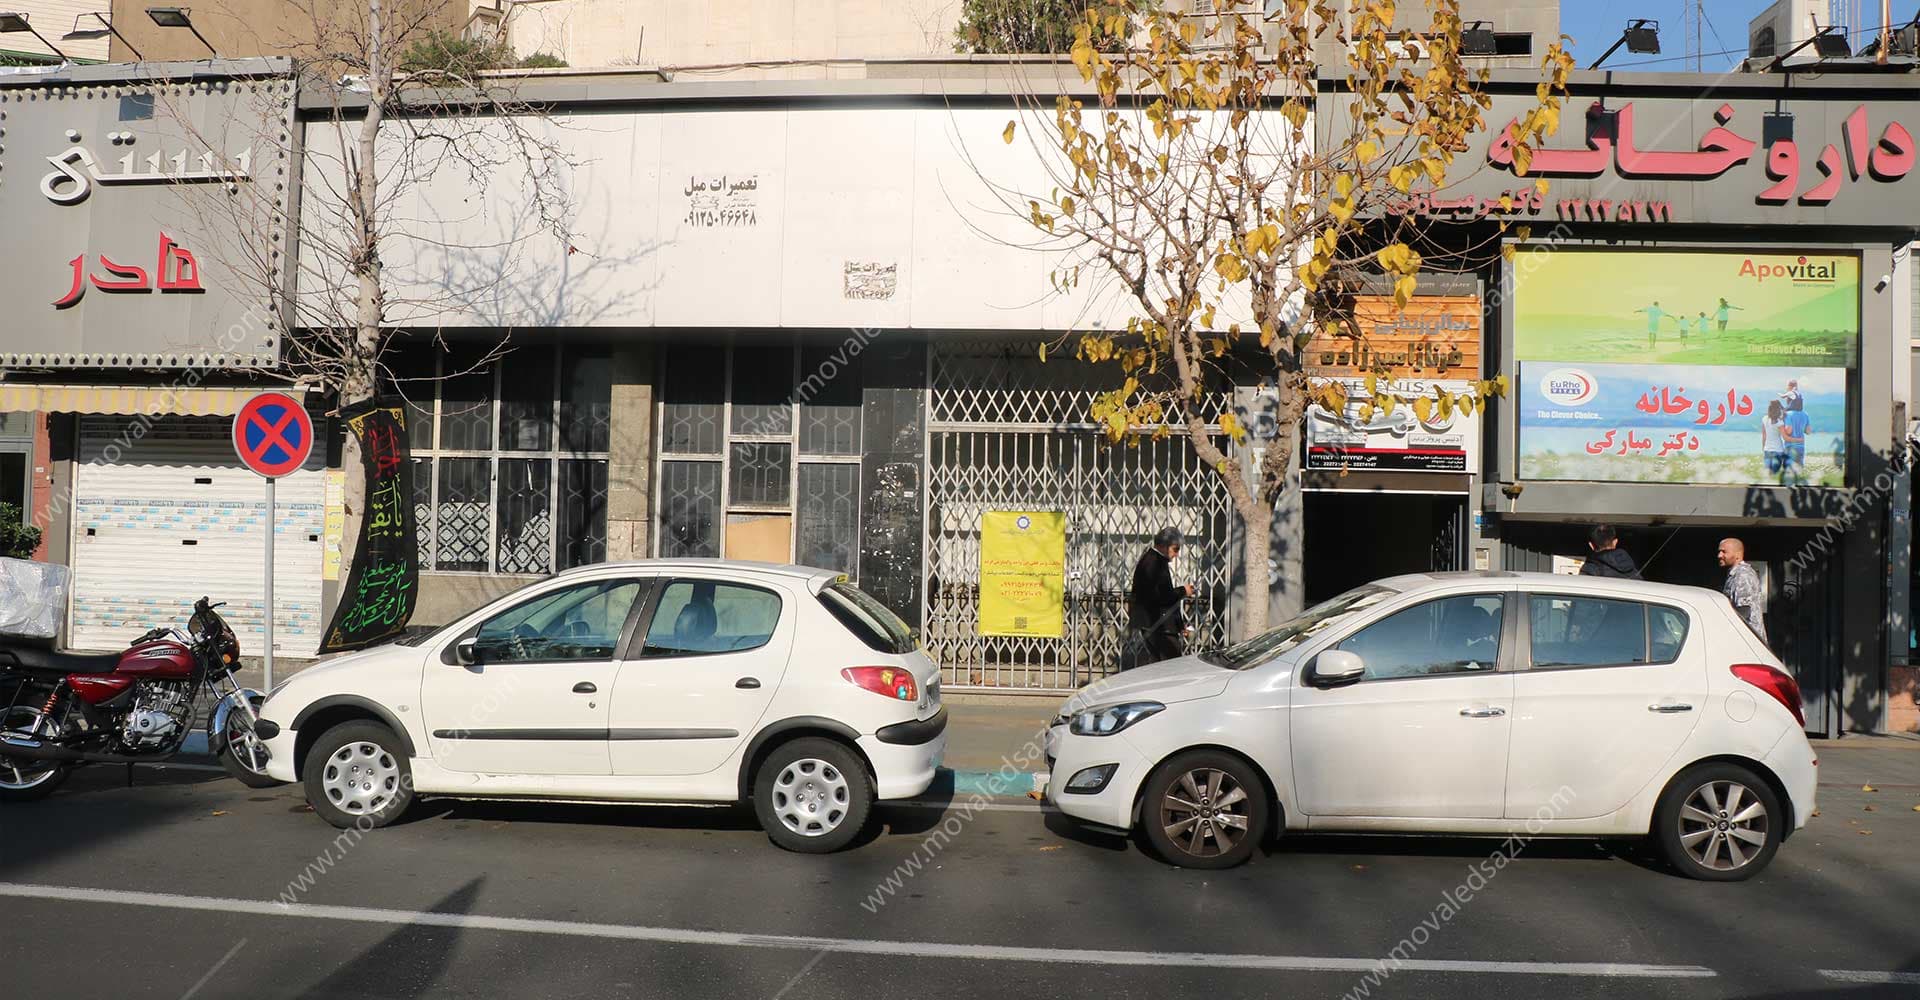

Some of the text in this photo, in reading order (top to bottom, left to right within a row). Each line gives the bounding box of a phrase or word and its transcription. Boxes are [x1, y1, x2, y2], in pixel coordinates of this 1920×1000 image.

[1488, 101, 1916, 205] داروخانه
[684, 174, 759, 197] تعمیرات مبل
[1738, 256, 1835, 283] Apovital
[1635, 385, 1754, 425] داروخانه
[1586, 428, 1700, 456] دکتر مبارکی
